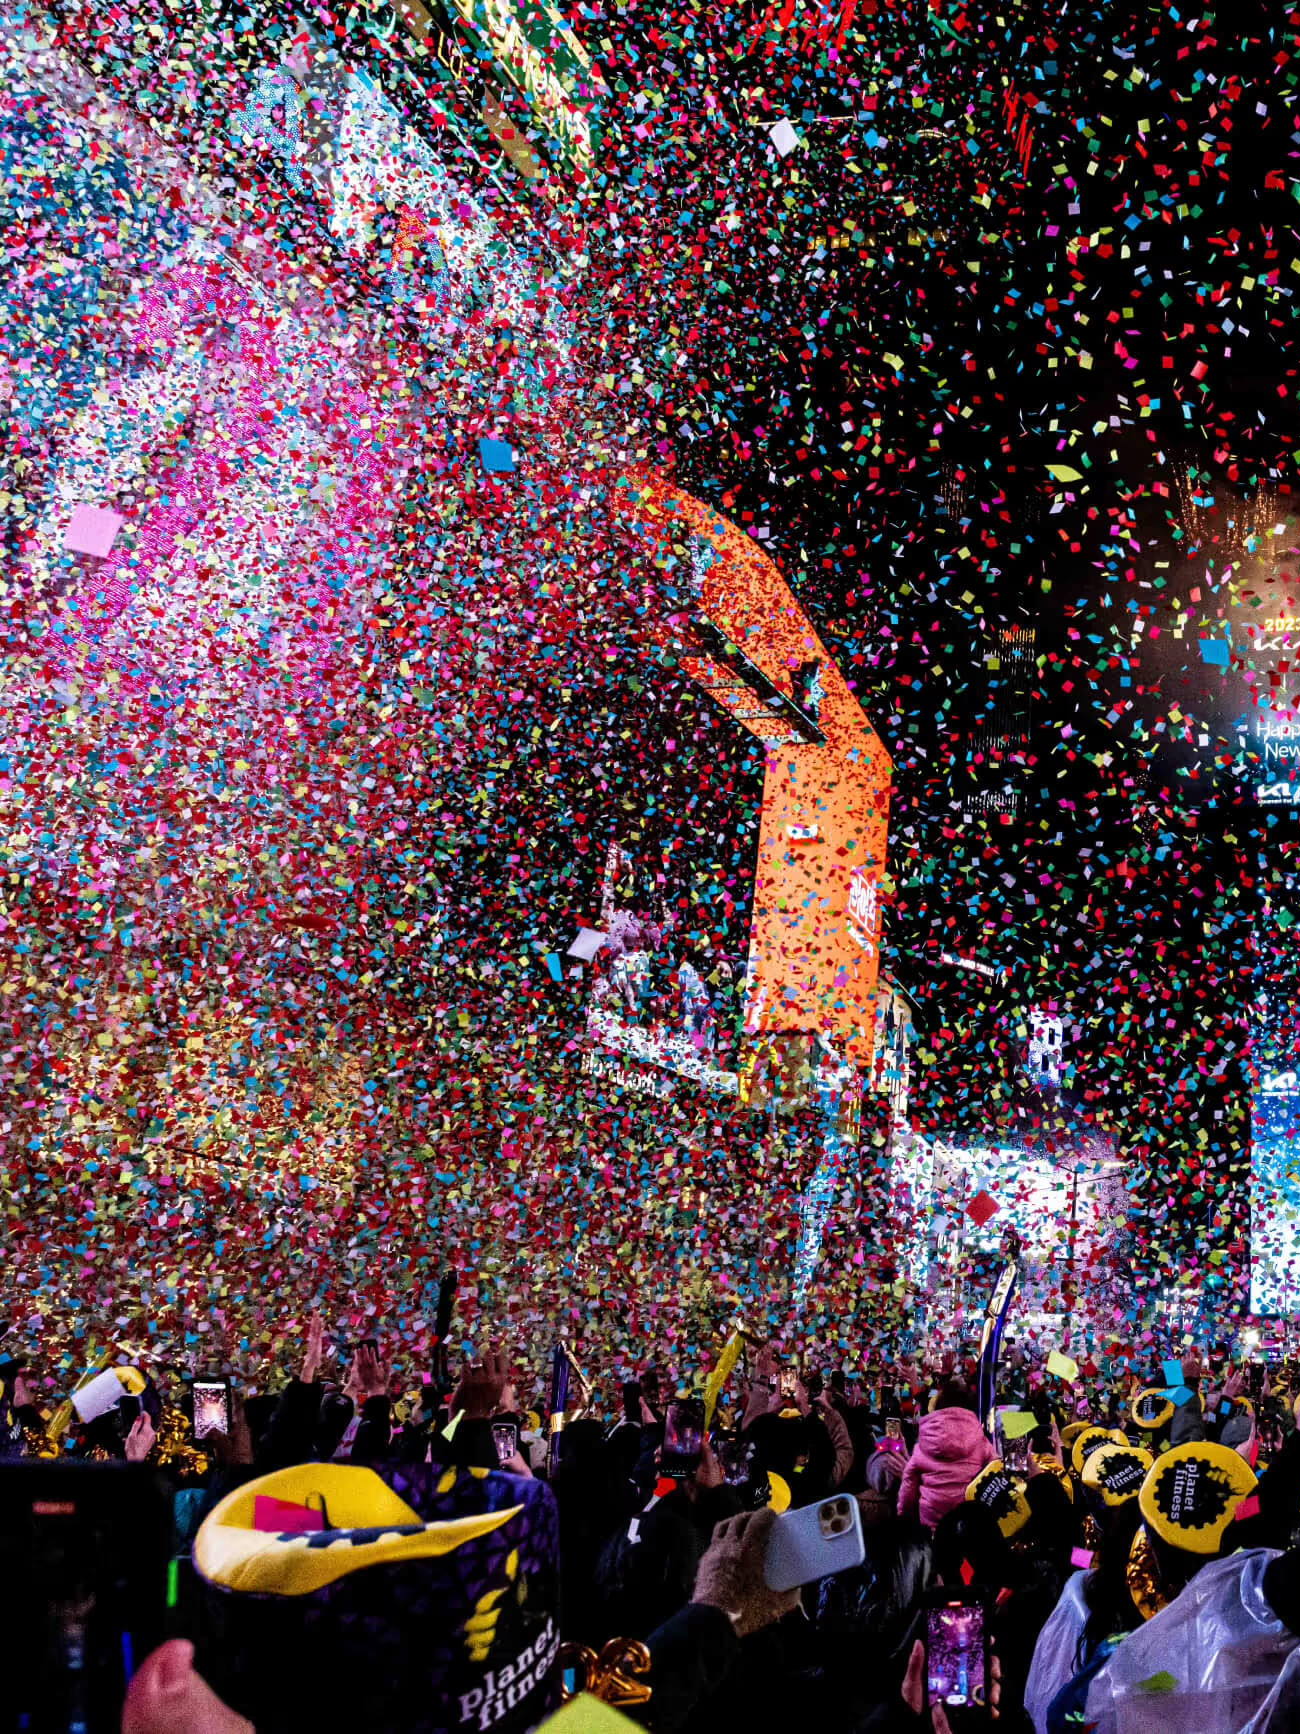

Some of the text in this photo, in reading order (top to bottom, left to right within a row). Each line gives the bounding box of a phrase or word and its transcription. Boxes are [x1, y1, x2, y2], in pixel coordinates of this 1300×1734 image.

[1105, 1465, 1134, 1487] planet
[1110, 1468, 1144, 1489] fitness
[1170, 1468, 1190, 1520] fitness
[1183, 1463, 1199, 1511] planet
[458, 1616, 553, 1723] planet
